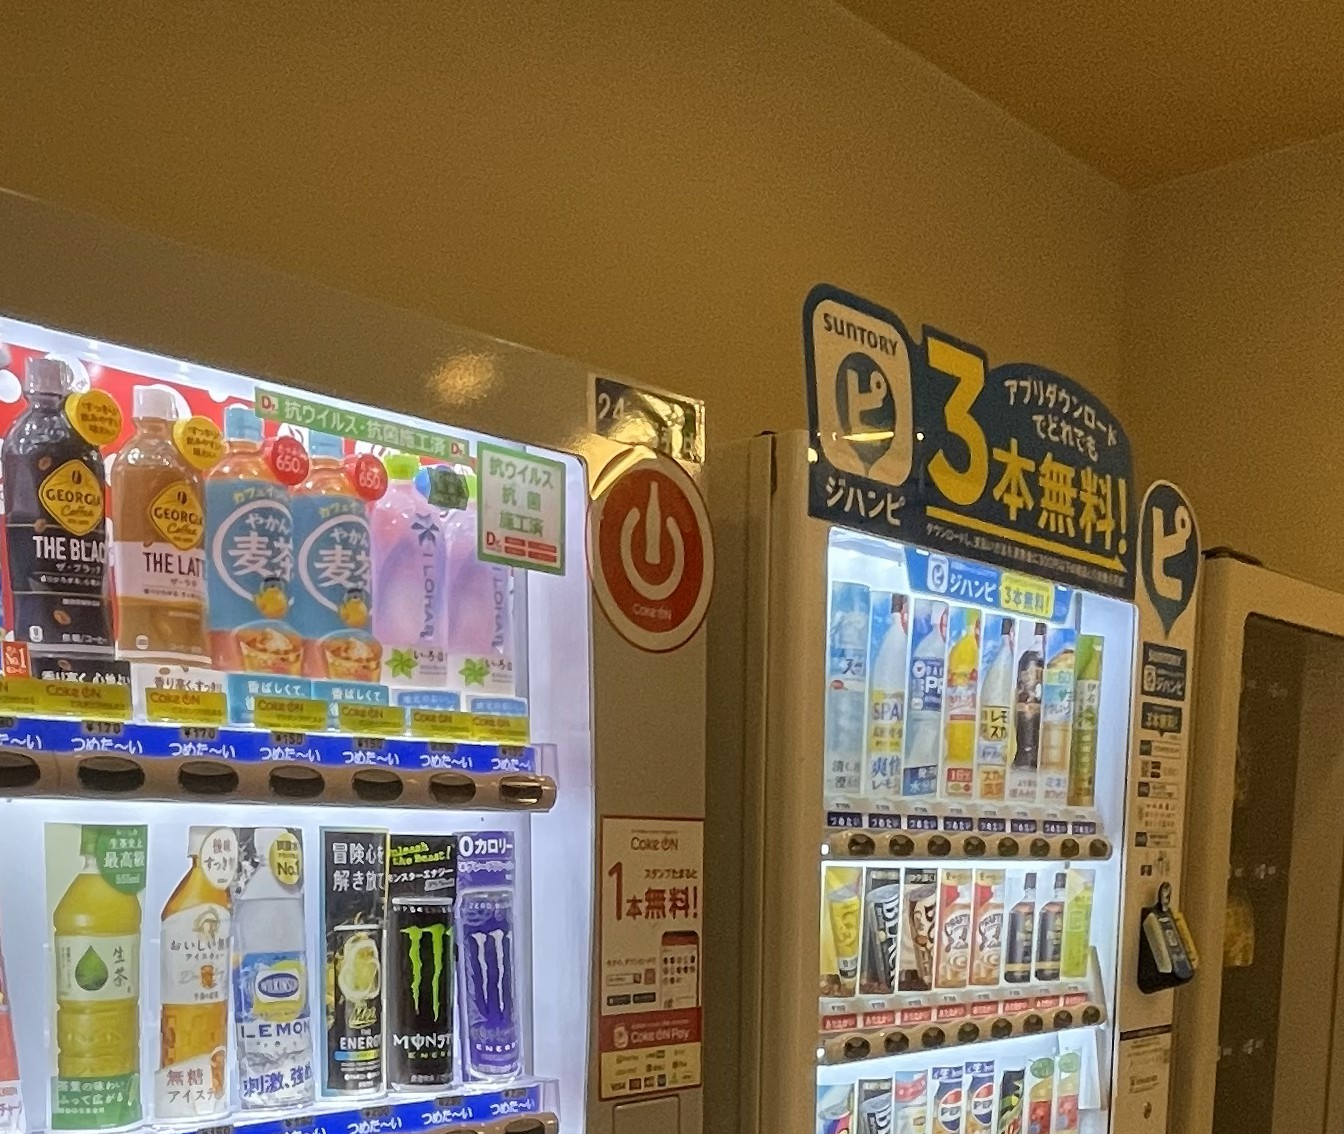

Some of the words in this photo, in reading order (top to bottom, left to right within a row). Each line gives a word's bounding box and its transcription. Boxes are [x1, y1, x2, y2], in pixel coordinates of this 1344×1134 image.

[1031, 413, 1101, 463] でどれでも
[276, 456, 300, 473] 650
[488, 455, 555, 489] 抗ウイルス
[359, 472, 381, 489] 650
[824, 475, 907, 527] ジハンピ
[245, 512, 291, 536] やかん
[32, 535, 67, 560] THE
[143, 552, 173, 574] THE
[947, 569, 997, 606] ジハンピ
[71, 737, 144, 755] つめた〜い
[259, 746, 321, 764] つめた〜い
[419, 753, 474, 770] つめた〜い
[459, 835, 514, 857] 0カロリー
[421, 1106, 474, 1127] つめた〜い
